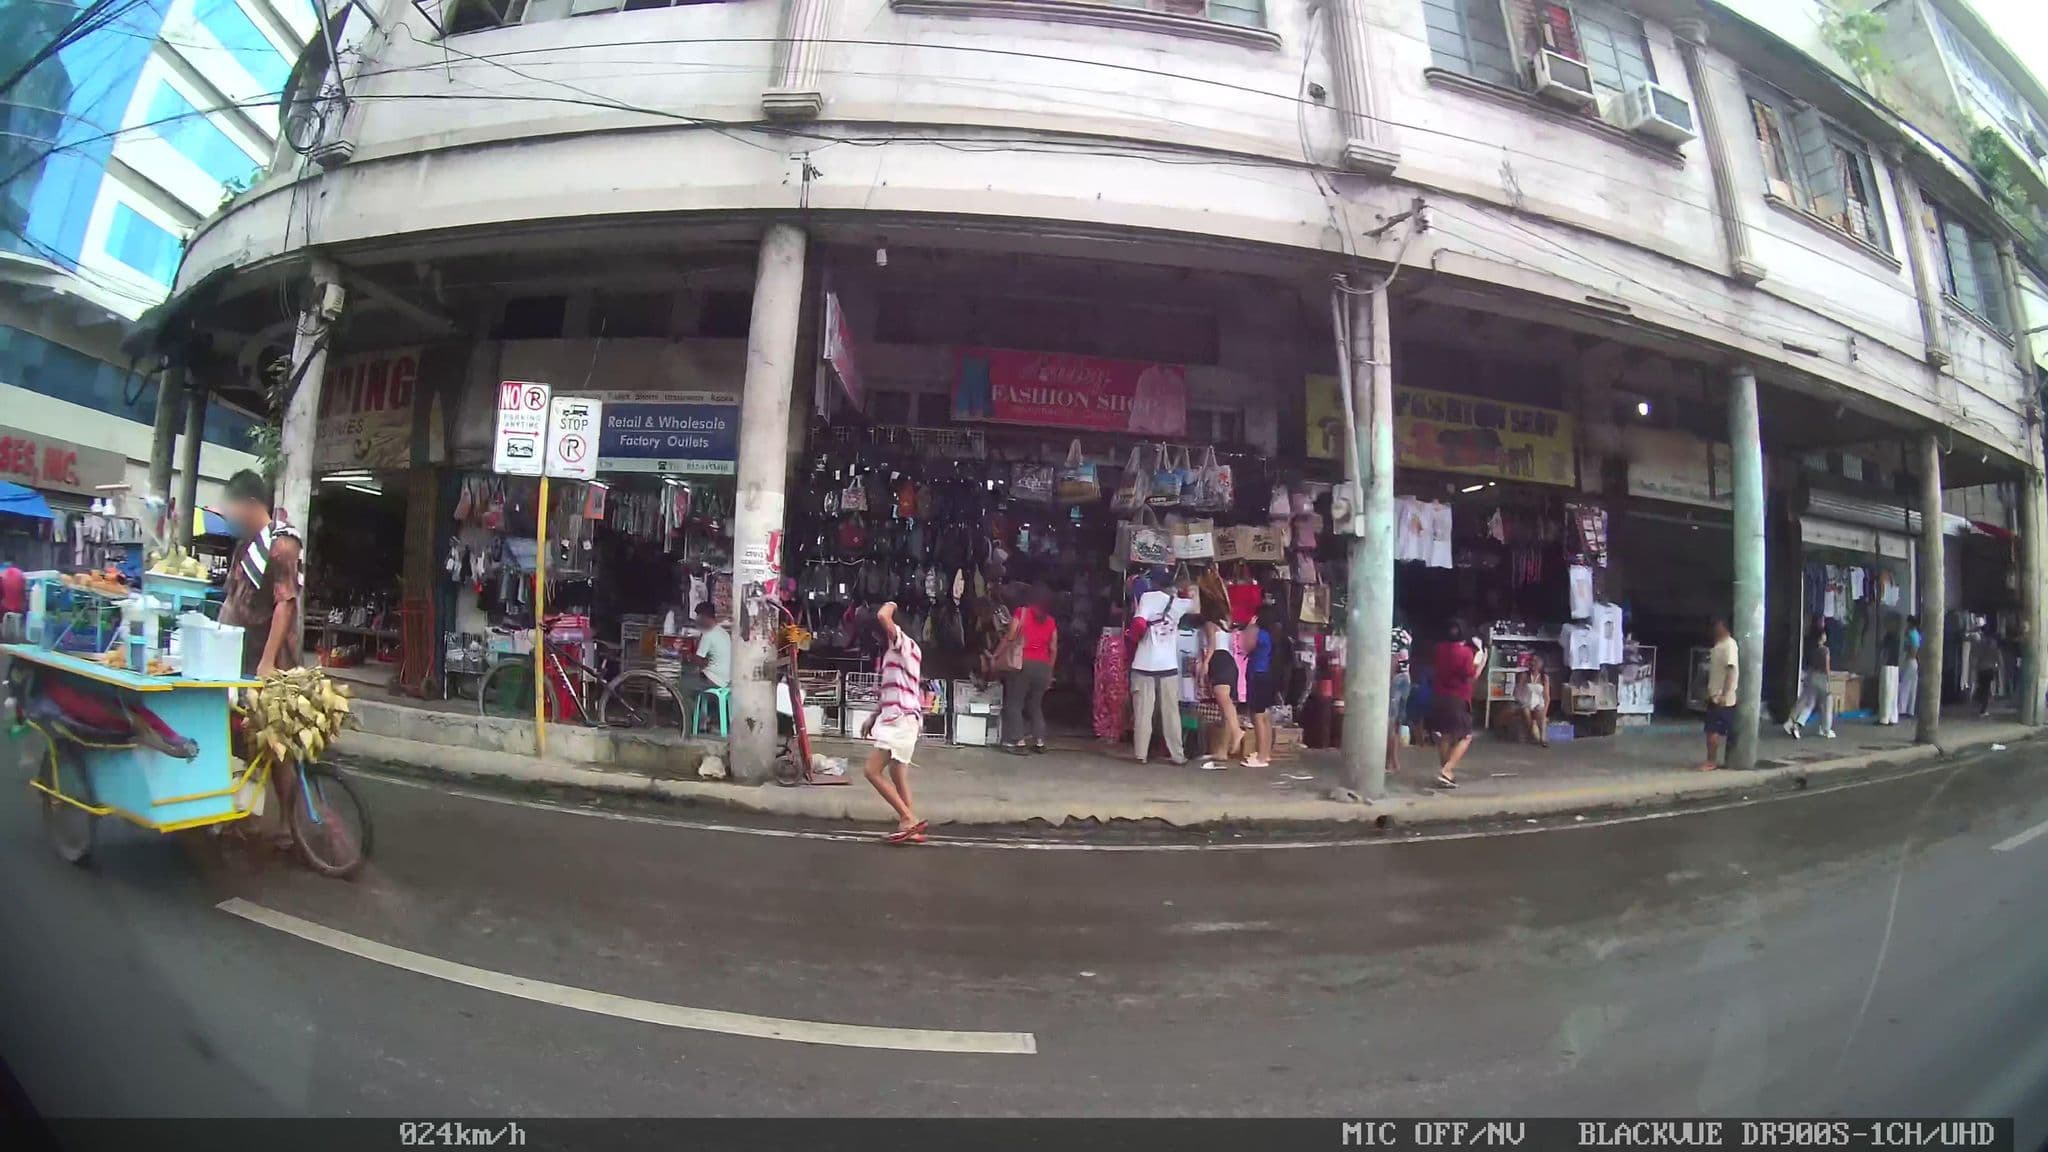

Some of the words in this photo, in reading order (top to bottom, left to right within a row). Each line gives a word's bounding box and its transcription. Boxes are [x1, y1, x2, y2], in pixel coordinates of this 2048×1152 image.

[501, 384, 521, 411] NO
[991, 384, 1090, 409] FASHION
[560, 418, 589, 431] STOP
[607, 415, 641, 429] Retail
[645, 417, 655, 428] &
[658, 417, 726, 430] Wholesale
[619, 434, 661, 449] Factory
[667, 435, 709, 449] Outlets
